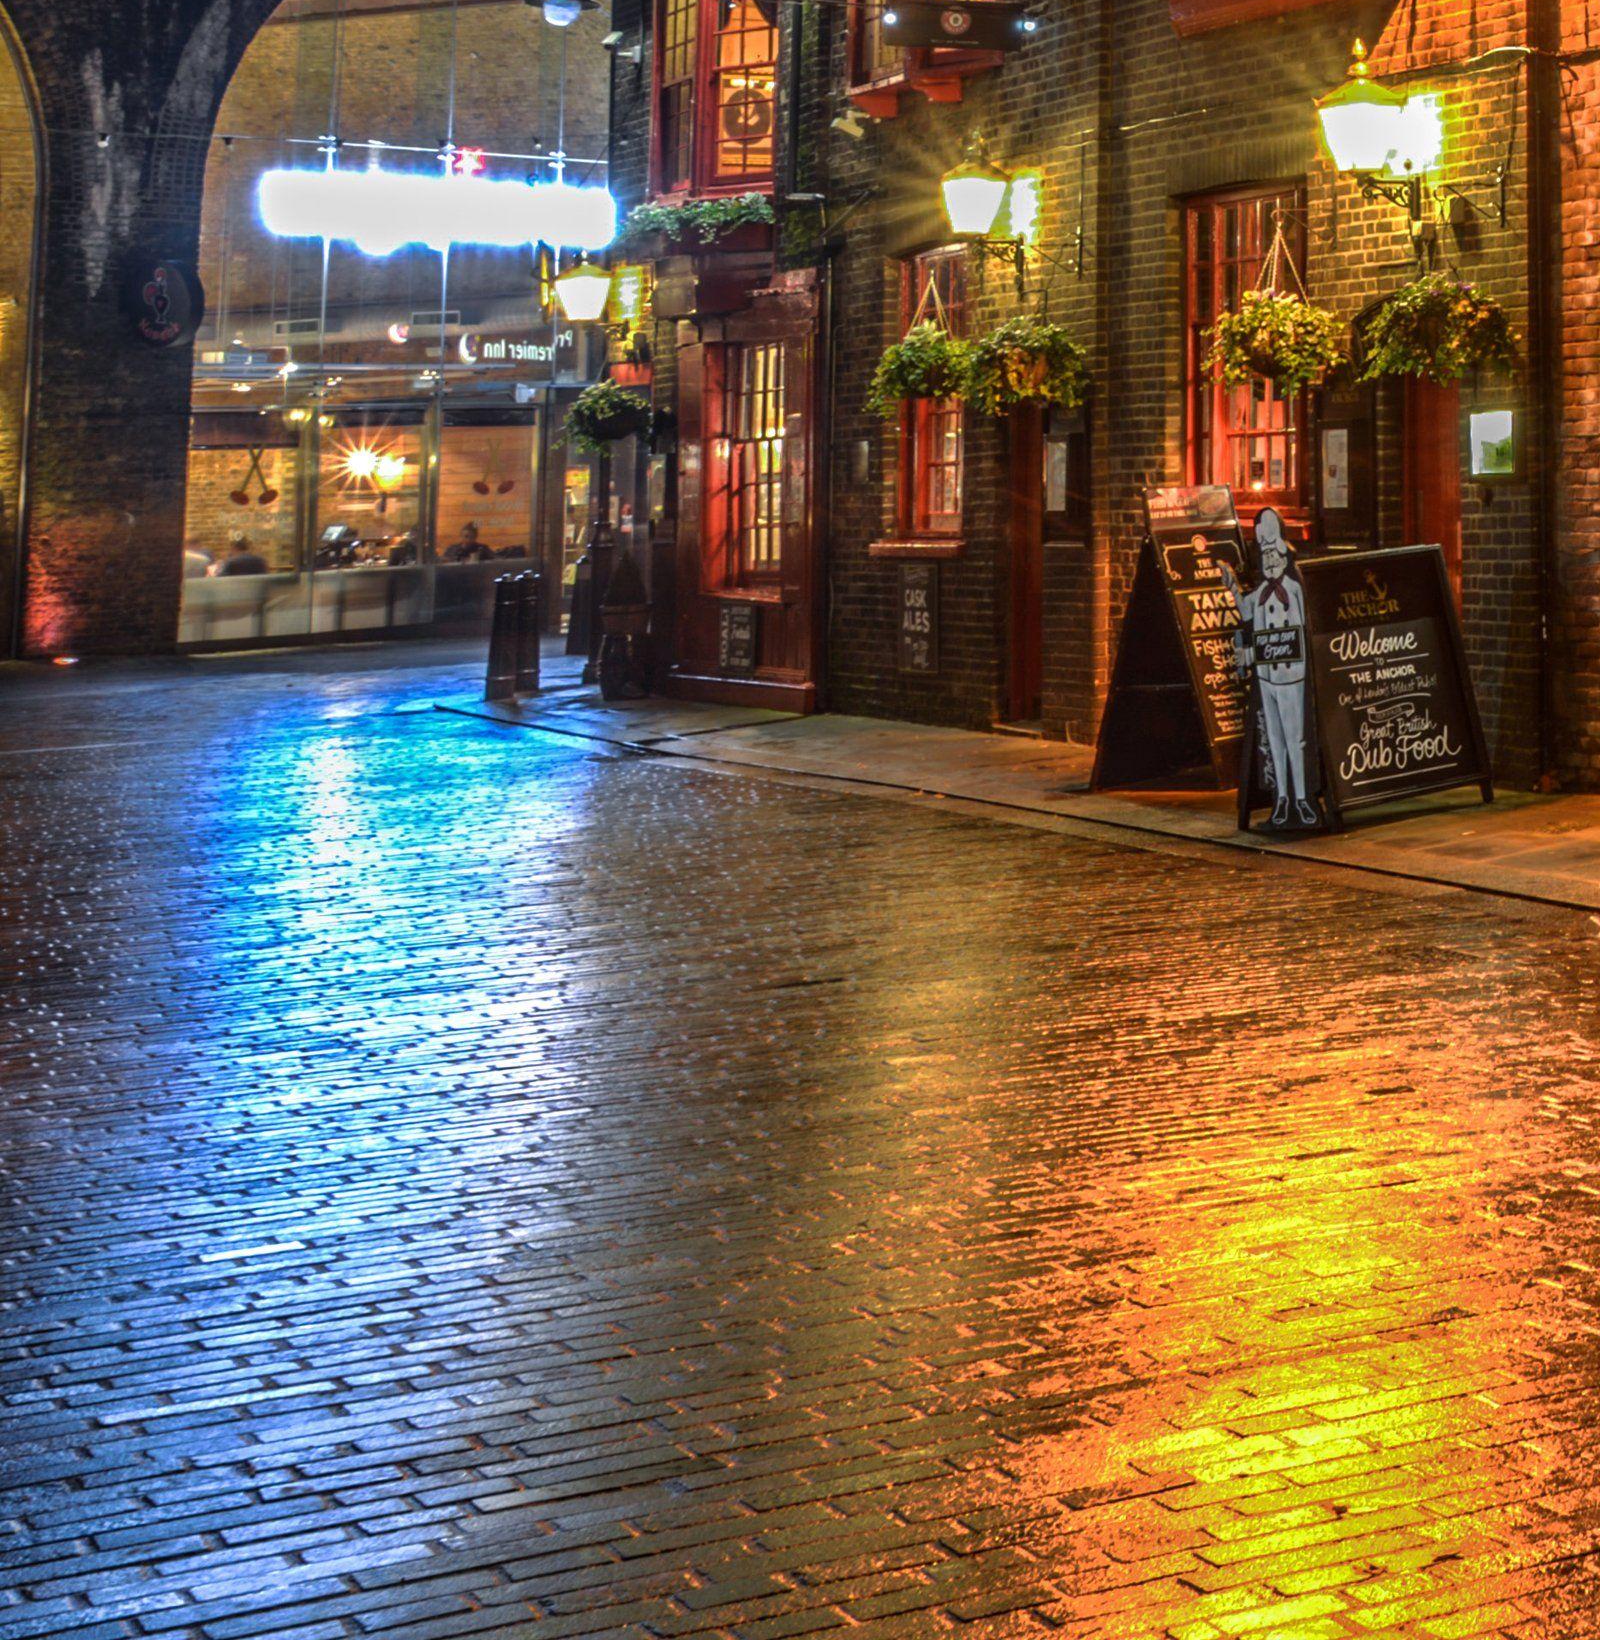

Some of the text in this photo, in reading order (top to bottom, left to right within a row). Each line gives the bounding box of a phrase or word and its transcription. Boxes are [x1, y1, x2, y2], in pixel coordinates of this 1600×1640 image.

[1188, 590, 1236, 611] TAKE
[1340, 590, 1369, 605] THE
[1336, 599, 1400, 622] ANCHOR
[902, 611, 931, 633] ALES
[1263, 644, 1294, 660] Open
[1330, 627, 1418, 661] Welcome
[1350, 664, 1417, 684] THE ANCHOR
[1359, 722, 1395, 749] Great
[1397, 708, 1438, 736] British
[1396, 725, 1462, 769] Food
